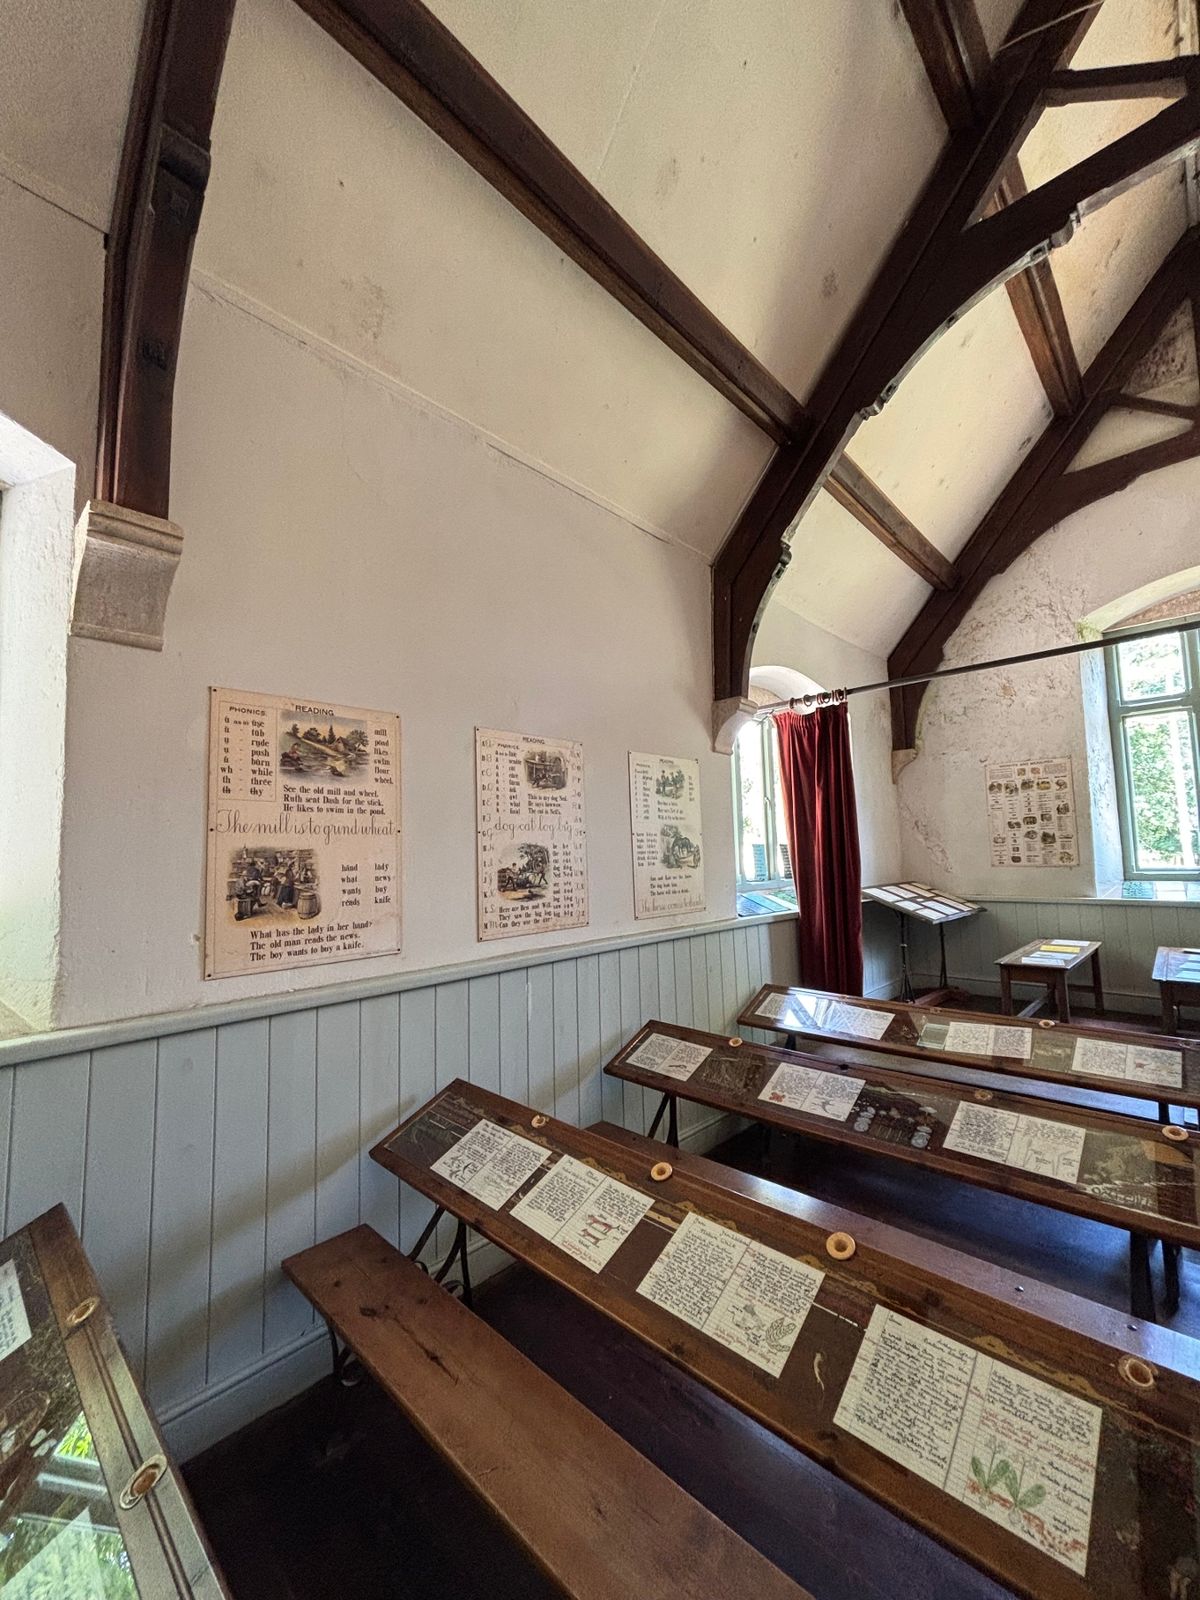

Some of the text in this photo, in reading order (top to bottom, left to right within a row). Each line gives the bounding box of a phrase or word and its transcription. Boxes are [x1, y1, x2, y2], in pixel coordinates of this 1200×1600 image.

[283, 784, 297, 794] See
[299, 786, 311, 794] the
[313, 787, 324, 795] old
[327, 788, 341, 796] mill
[283, 794, 302, 803] Ruth
[305, 796, 320, 804] sent
[342, 797, 352, 805] for
[354, 798, 366, 806] the
[283, 803, 294, 812] He
[296, 804, 314, 813] likes
[326, 806, 344, 814] swim
[347, 806, 354, 814] in
[356, 807, 367, 815] the
[216, 809, 251, 834] The
[253, 812, 292, 834] mill
[293, 819, 306, 835] is
[306, 817, 322, 835] to
[250, 930, 272, 940] What
[276, 929, 290, 938] has
[293, 927, 305, 936] the
[308, 925, 324, 935] lady
[327, 924, 334, 932] in
[337, 923, 349, 931] her
[250, 941, 266, 950] The
[270, 940, 282, 949] old
[284, 939, 301, 947] man
[304, 936, 324, 945] reads
[326, 934, 337, 942] the
[250, 952, 266, 961] The
[270, 951, 284, 960] boy
[287, 948, 308, 957] wants
[320, 945, 333, 954] buy
